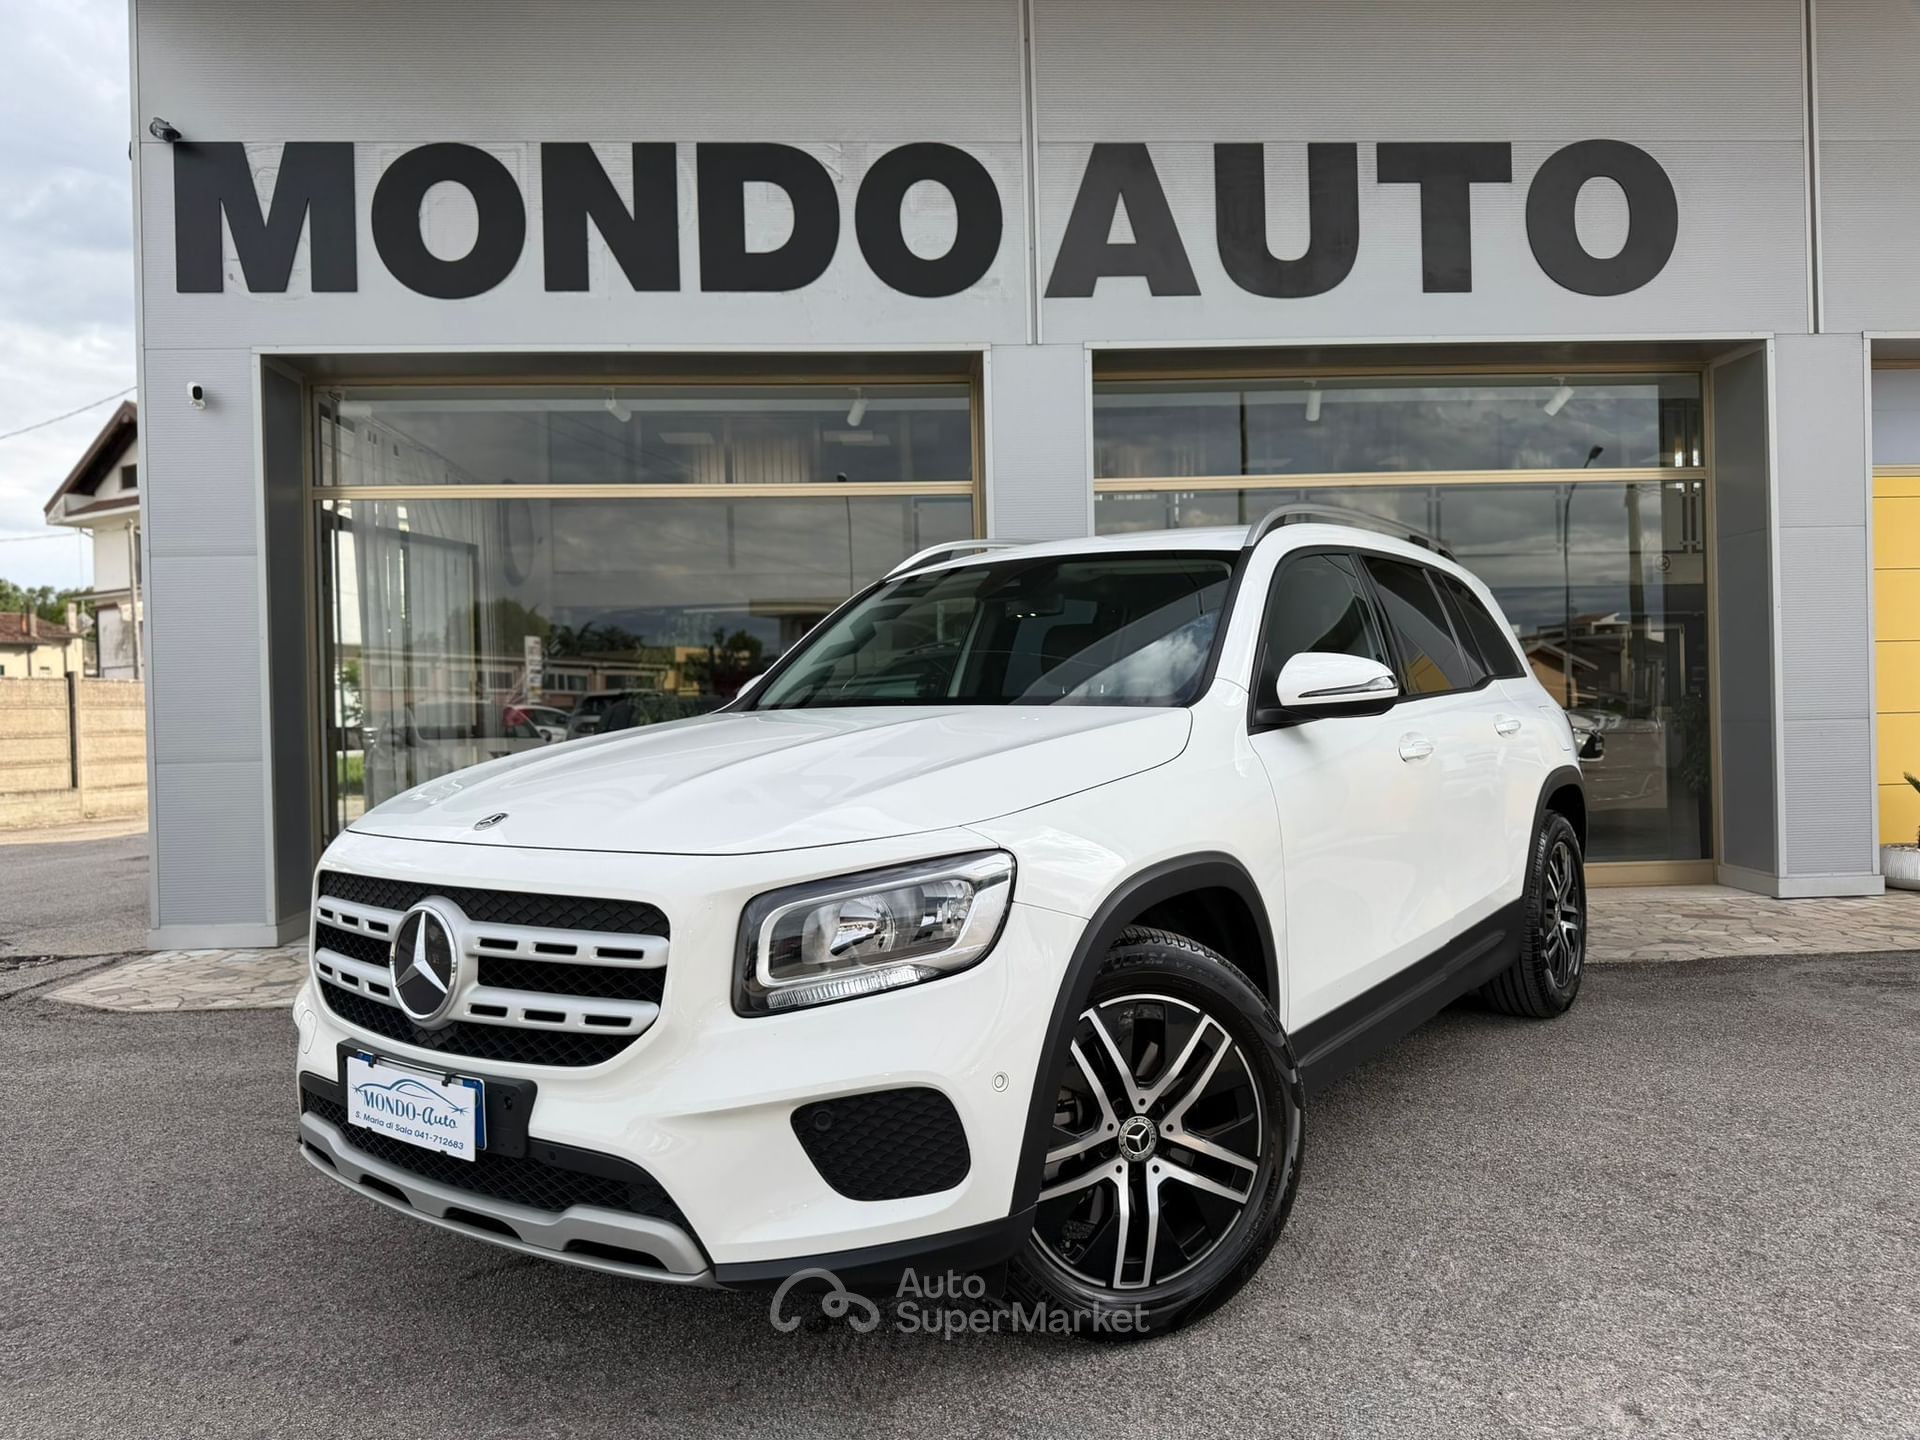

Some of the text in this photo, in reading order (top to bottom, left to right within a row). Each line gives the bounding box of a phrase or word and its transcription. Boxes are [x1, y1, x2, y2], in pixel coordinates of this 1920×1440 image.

[177, 138, 1679, 299] MONDO AUTO
[355, 1111, 464, 1150] S. Maria di Sala 041-712683
